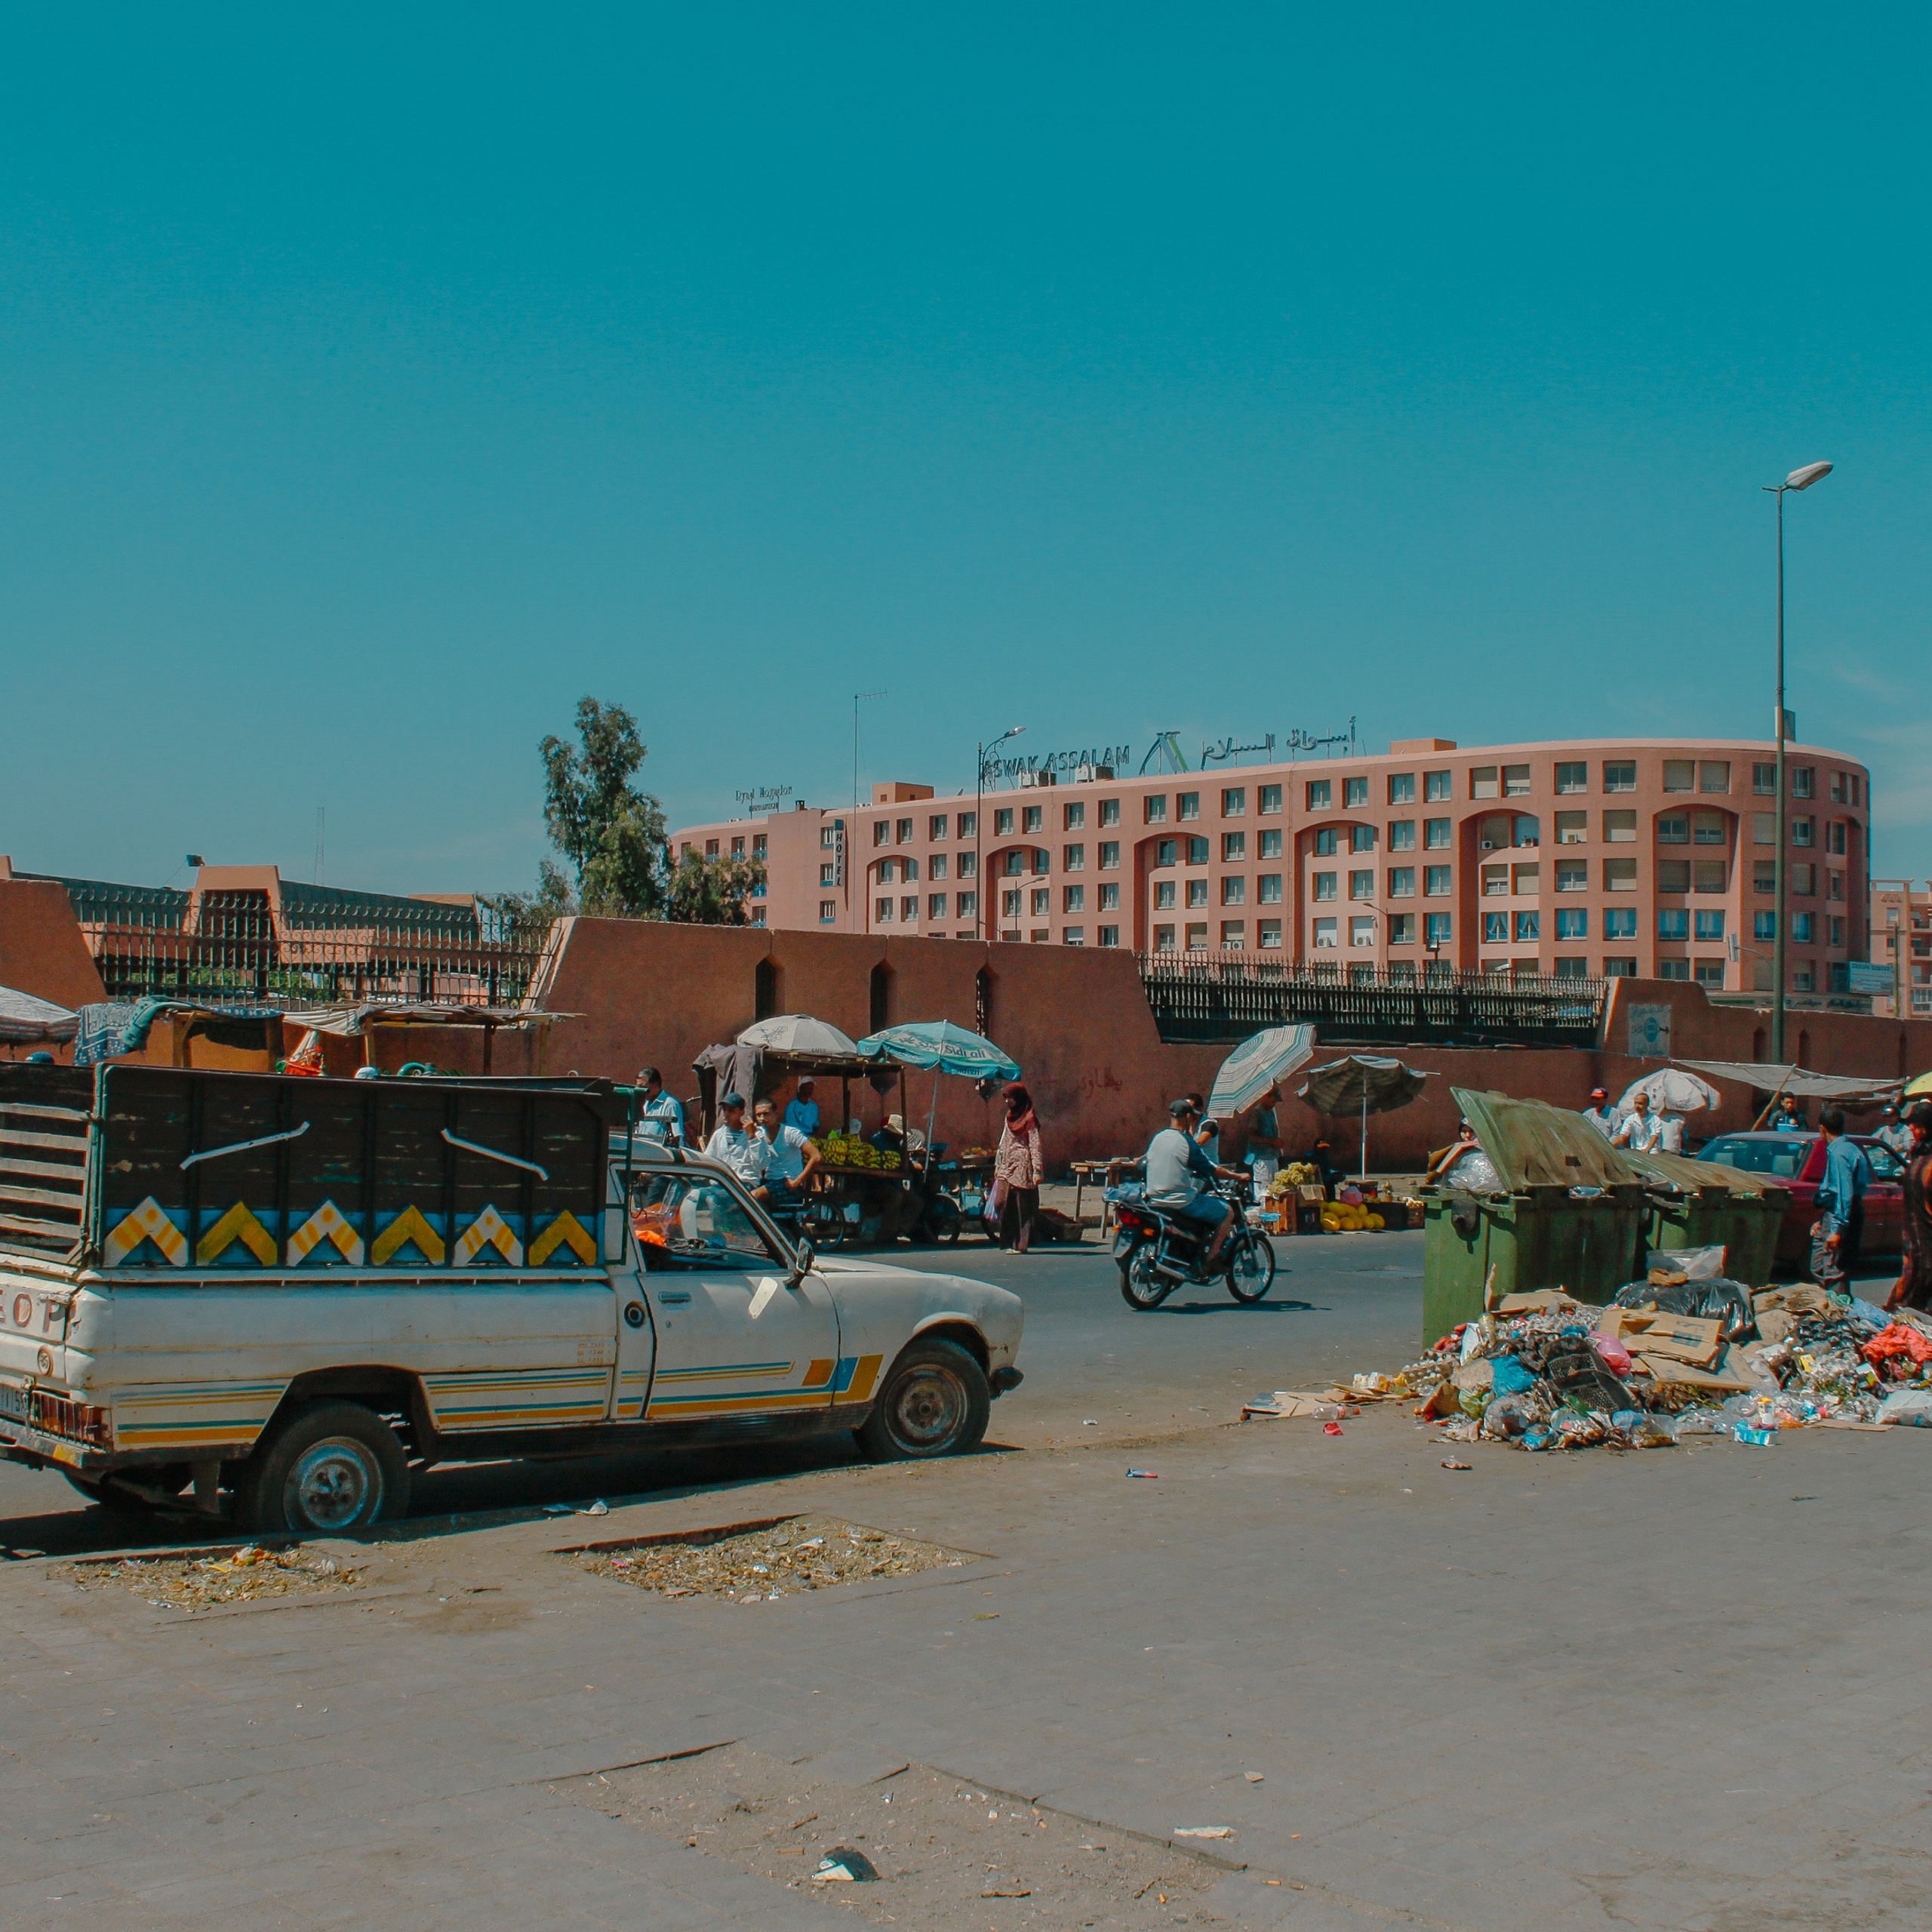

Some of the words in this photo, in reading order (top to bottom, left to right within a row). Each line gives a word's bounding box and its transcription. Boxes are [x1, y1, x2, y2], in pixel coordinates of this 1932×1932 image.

[1044, 746, 1130, 773] ASSALAM
[1201, 733, 1275, 770] السلام
[945, 1044, 966, 1057] Sidi
[971, 1048, 986, 1059] ali
